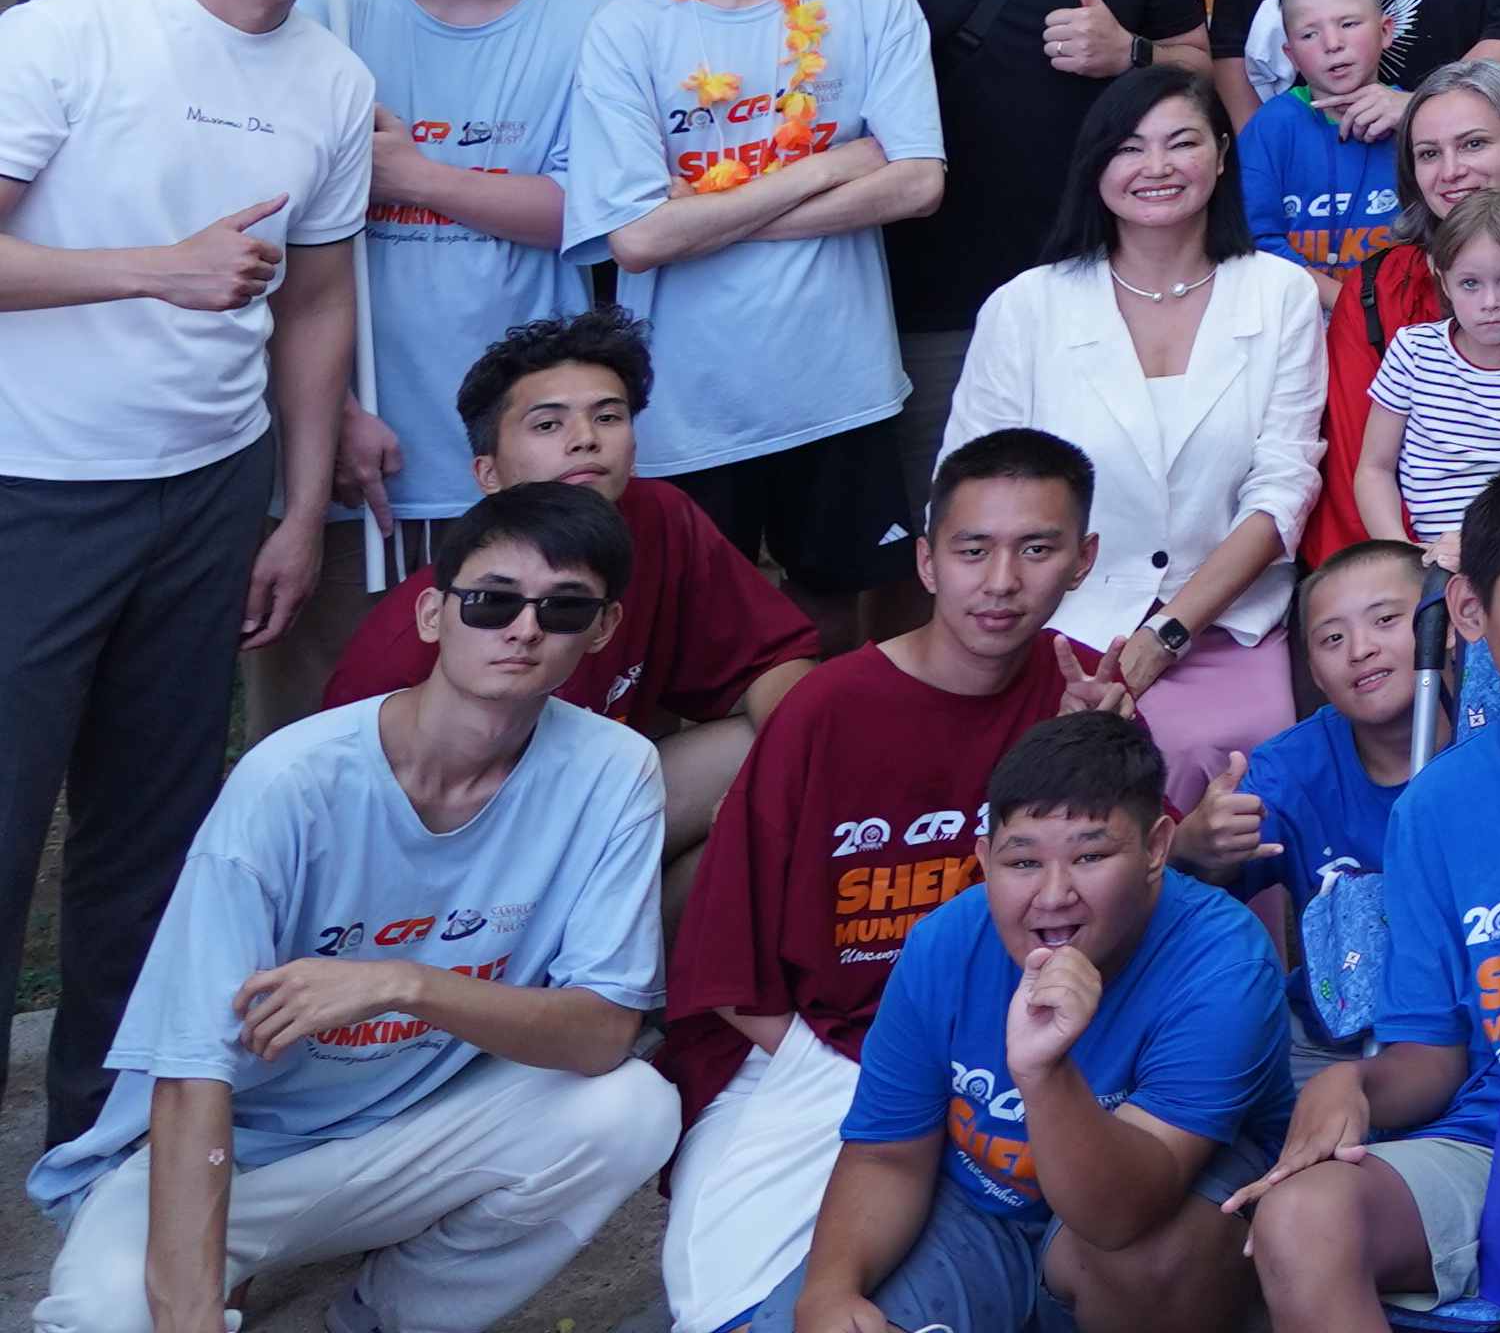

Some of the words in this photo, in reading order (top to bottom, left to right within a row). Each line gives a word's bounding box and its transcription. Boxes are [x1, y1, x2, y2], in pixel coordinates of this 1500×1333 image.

[670, 107, 715, 133] 20
[832, 817, 891, 858] 20
[836, 855, 980, 916] SHEK
[317, 923, 364, 956] 20
